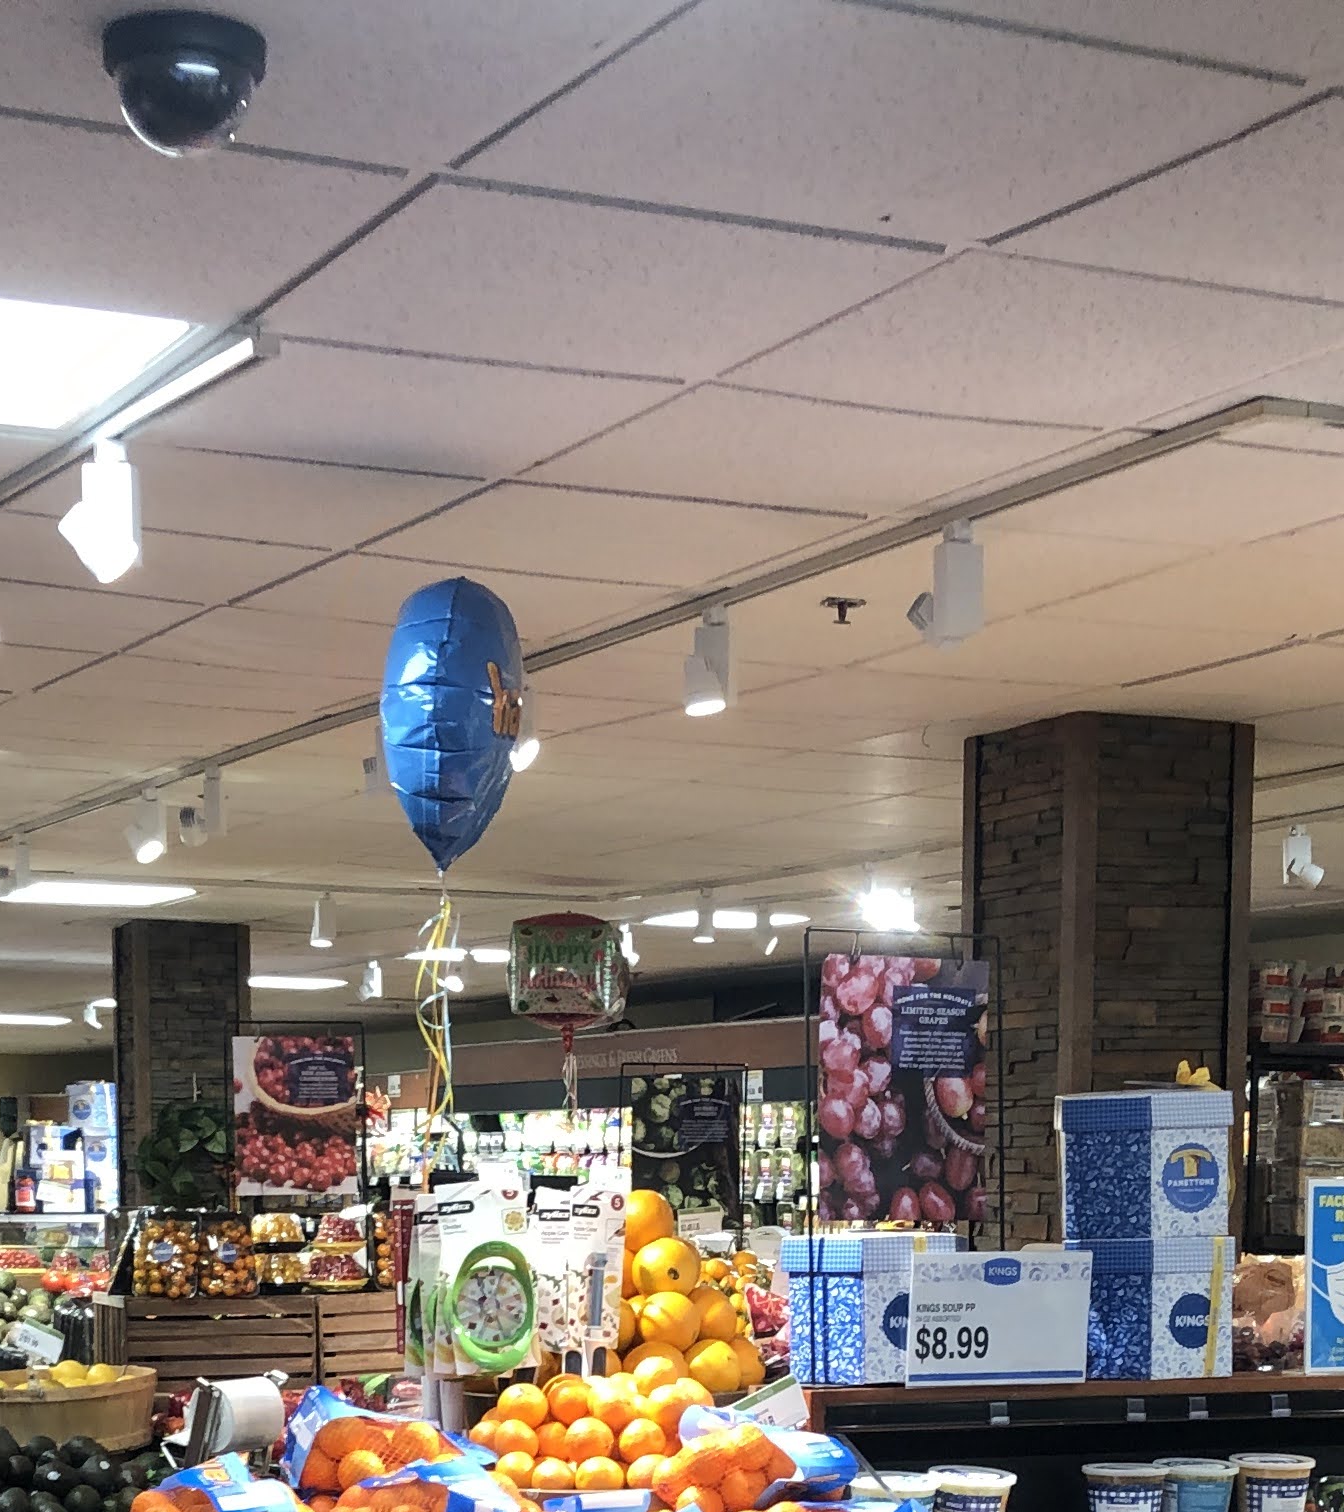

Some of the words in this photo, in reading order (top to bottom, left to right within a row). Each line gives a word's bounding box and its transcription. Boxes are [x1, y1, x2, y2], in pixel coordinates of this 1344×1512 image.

[1167, 1177, 1215, 1188] PANETTONE
[988, 1266, 1018, 1277] KINGS
[916, 1303, 941, 1313] KINGS
[942, 1303, 963, 1313] SOUP
[965, 1303, 976, 1312] PP
[915, 1324, 989, 1364] $8.99
